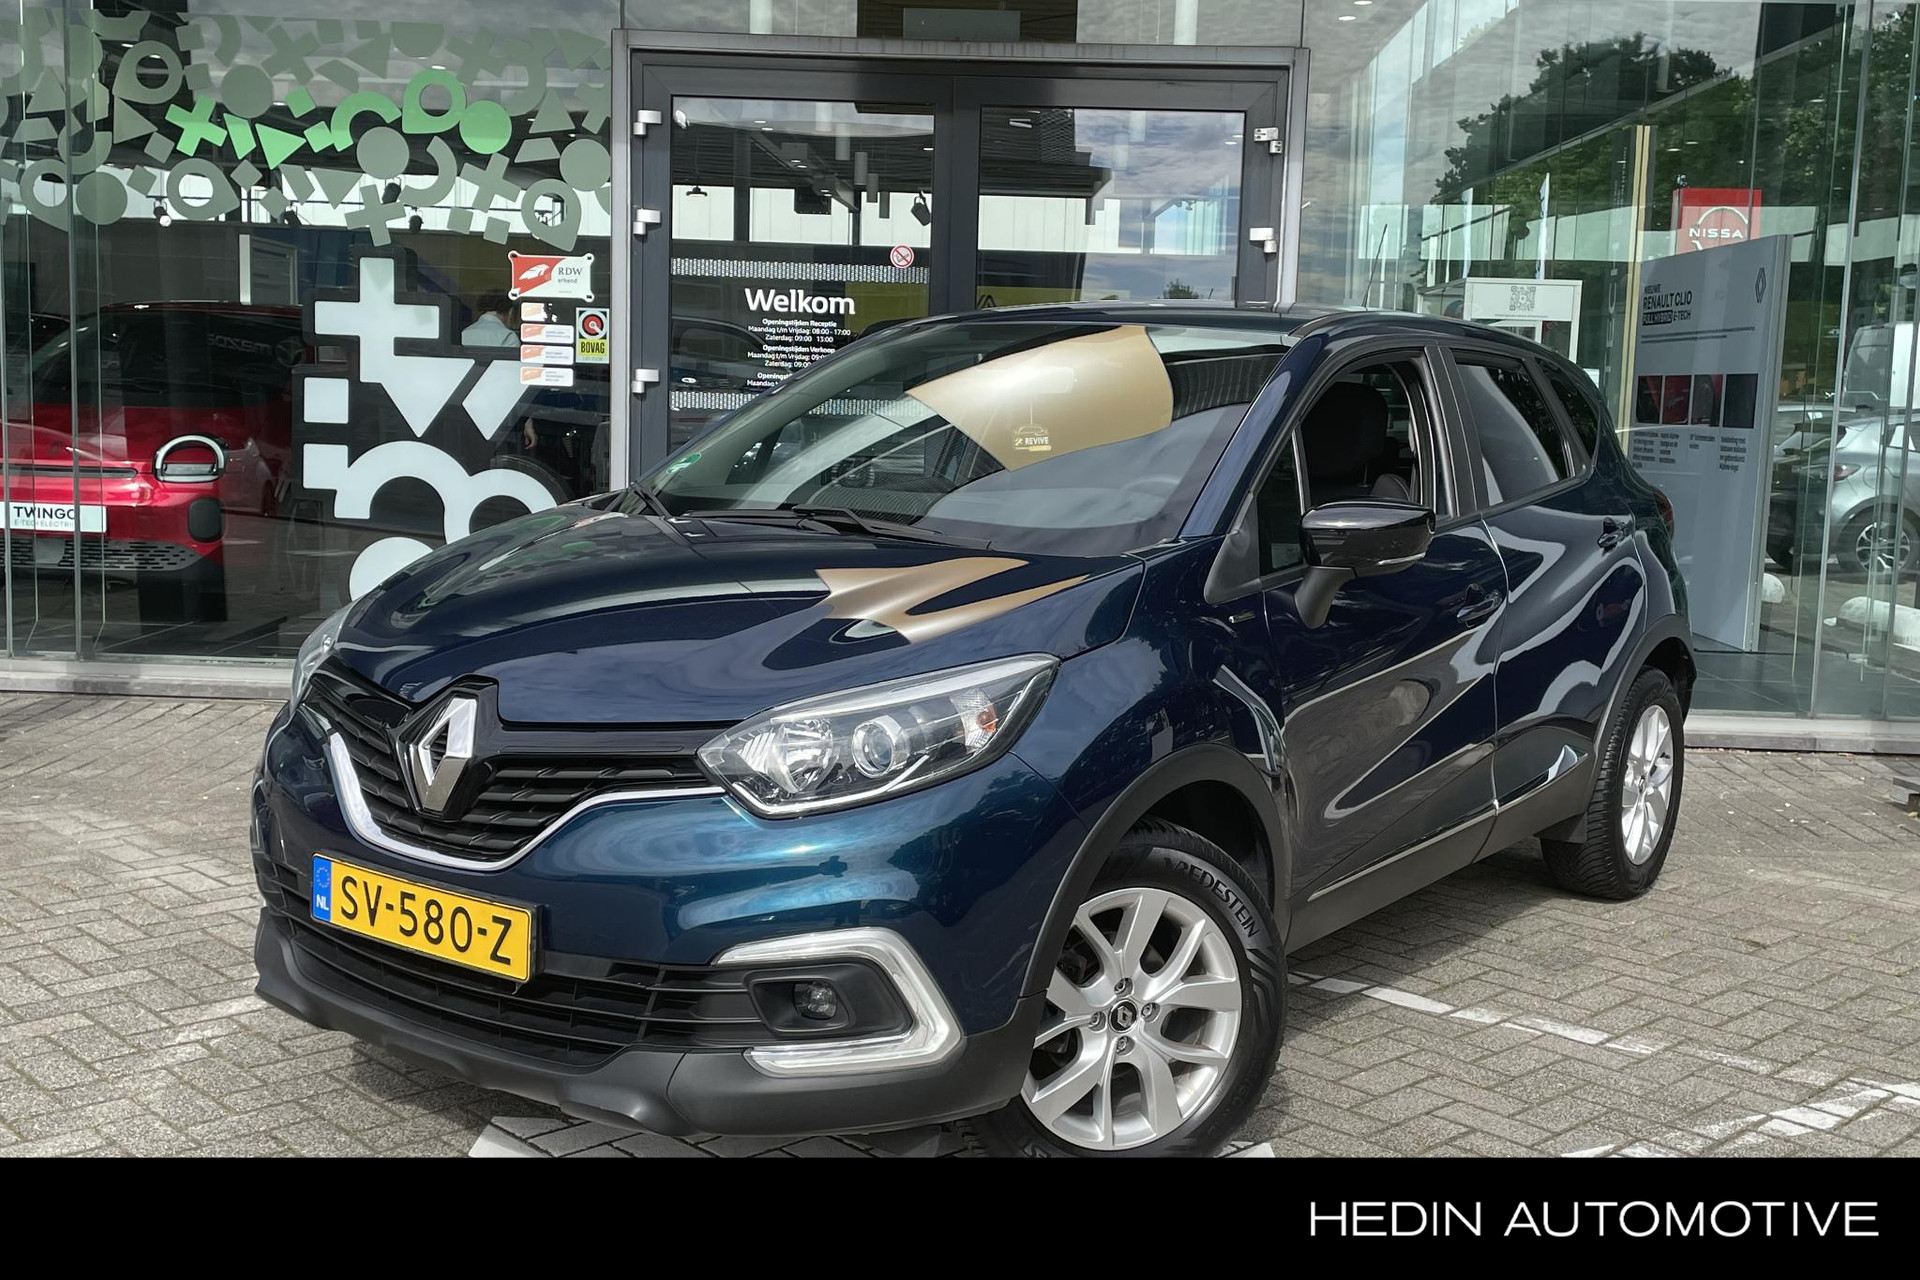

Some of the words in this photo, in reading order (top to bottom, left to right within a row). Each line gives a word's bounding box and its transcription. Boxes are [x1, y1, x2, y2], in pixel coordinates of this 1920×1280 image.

[1688, 227, 1744, 239] NISSA
[558, 266, 582, 276] RDW
[744, 287, 856, 315] Welkom
[1643, 293, 1674, 310] RENAULT
[1675, 290, 1692, 306] CLIO
[762, 318, 809, 328] Openingstijden
[810, 320, 837, 328] Receptie
[748, 325, 776, 334] Maandag
[776, 326, 788, 334] t/m
[788, 327, 811, 335] Vrijdag:
[765, 333, 794, 342] Zaterdag:
[580, 341, 605, 354] BOVAG
[762, 344, 809, 354] Openingstijden
[747, 351, 775, 359] Maandag
[1025, 436, 1049, 445] REVIVE
[316, 894, 330, 911] NL
[340, 875, 512, 966] SV-580-Z
